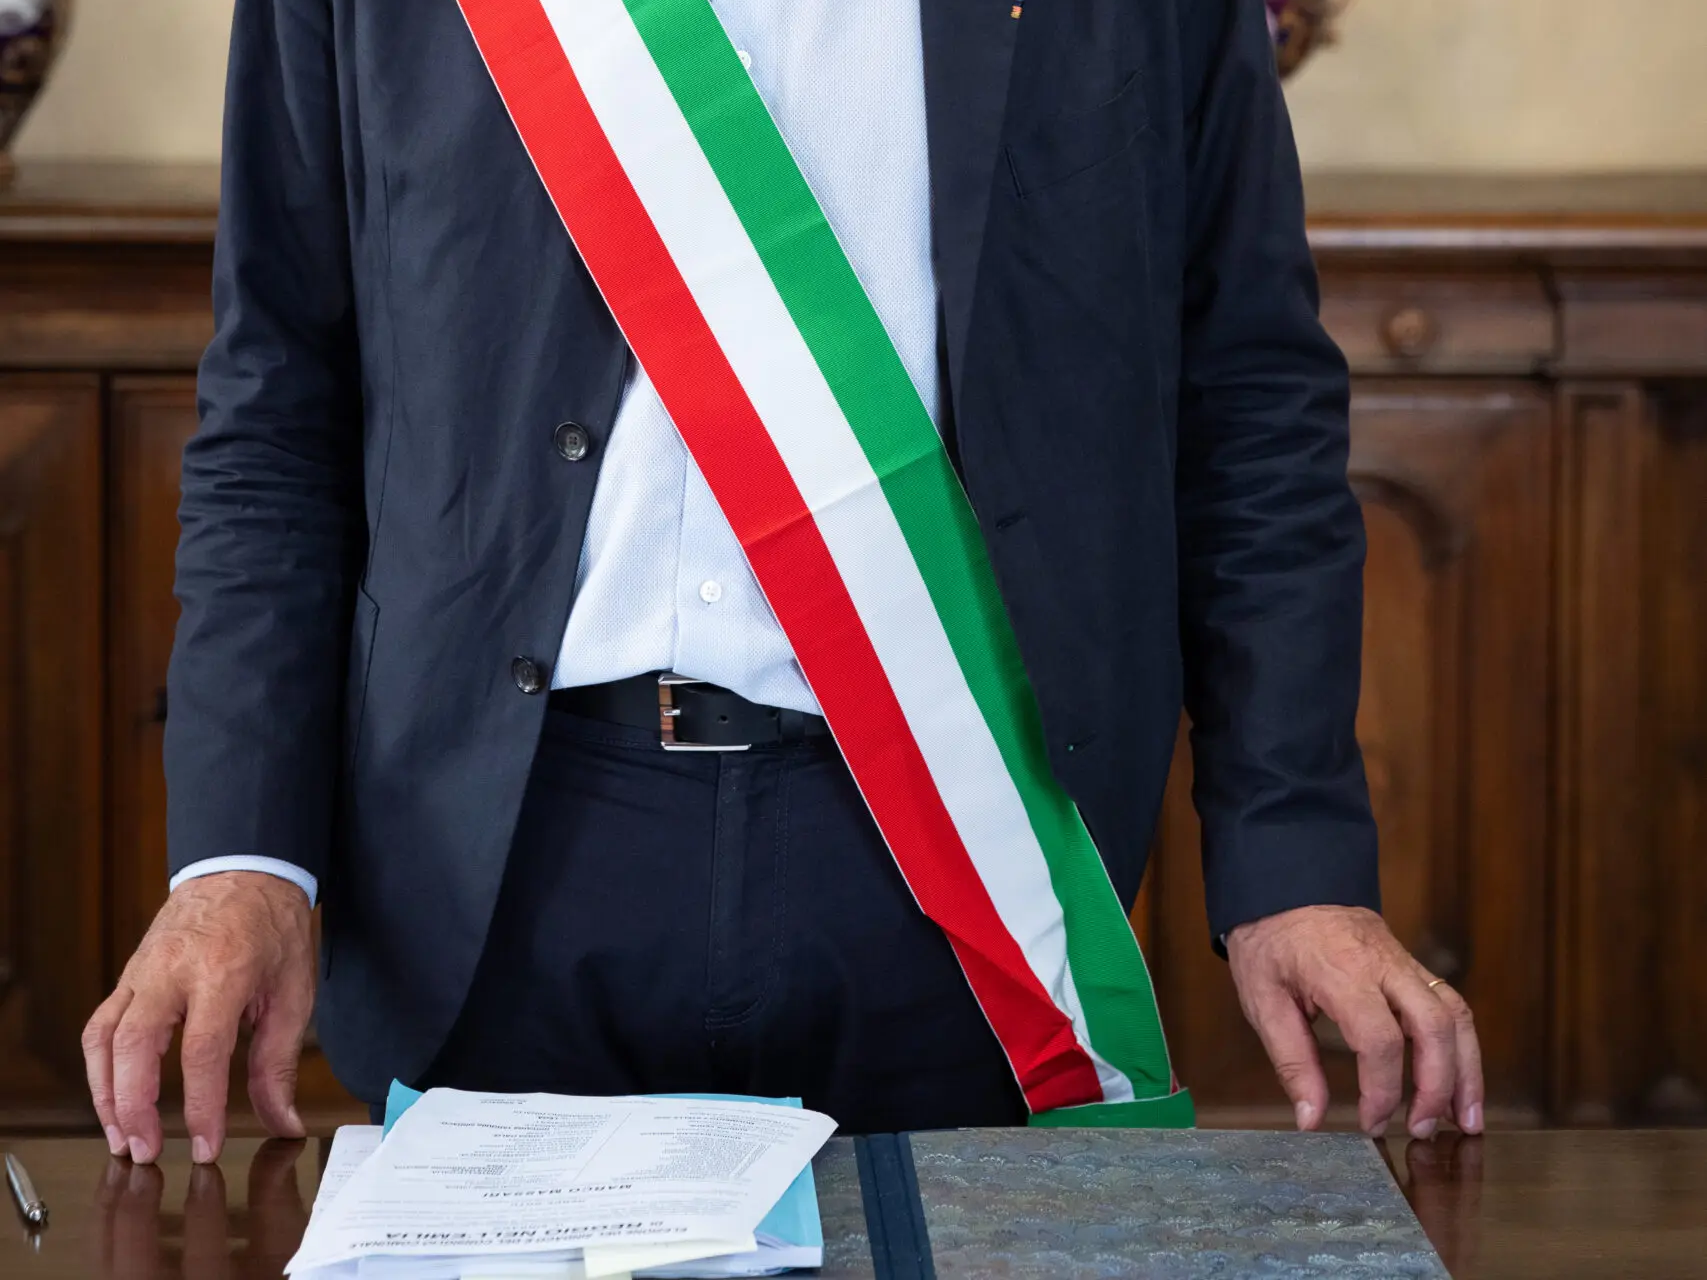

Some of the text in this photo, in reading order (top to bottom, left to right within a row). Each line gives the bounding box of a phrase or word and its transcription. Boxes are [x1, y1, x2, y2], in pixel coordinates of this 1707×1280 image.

[482, 1184, 633, 1198] MARCO MASSARI
[385, 1230, 537, 1239] NELL'EMILIA
[544, 1222, 643, 1235] REGGIO
